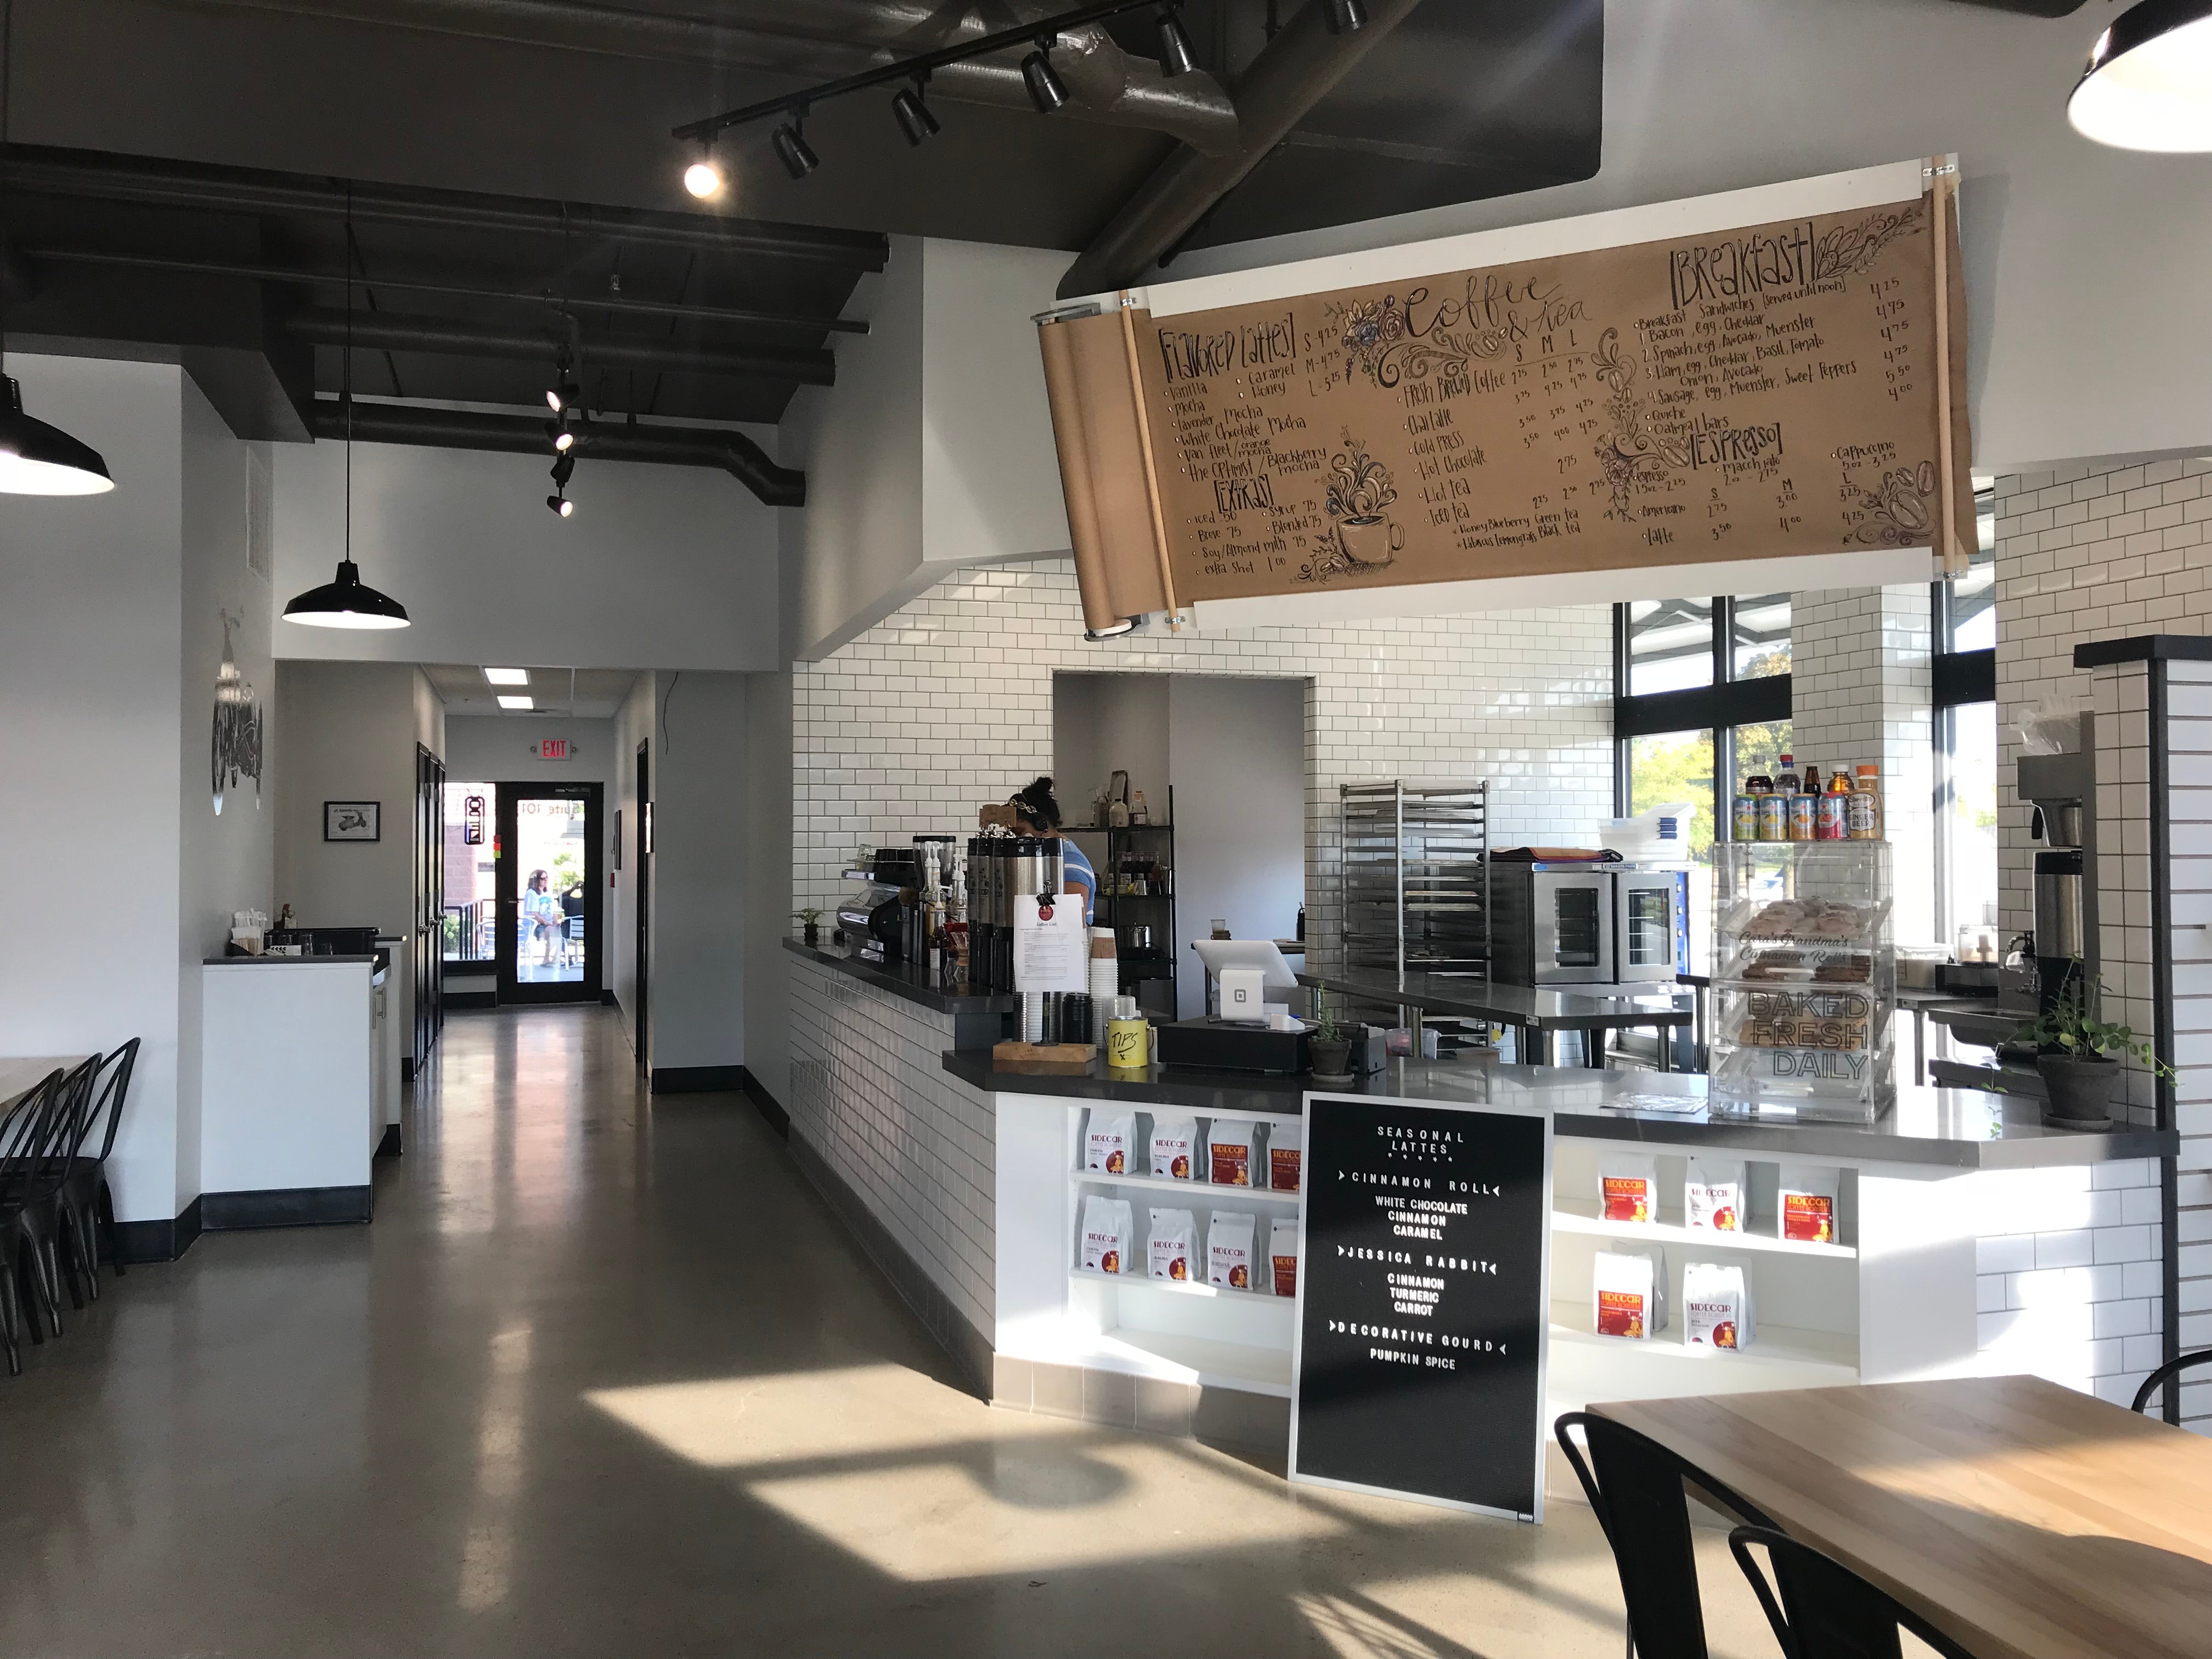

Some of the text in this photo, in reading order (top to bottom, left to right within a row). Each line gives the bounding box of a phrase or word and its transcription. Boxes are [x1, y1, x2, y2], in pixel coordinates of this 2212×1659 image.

[1402, 275, 1562, 337] Coffee
[1639, 309, 1686, 330] Breakfast
[1700, 294, 1754, 319] Sandwiches
[1507, 311, 1529, 342] &
[1724, 314, 1765, 330] Cheddar
[1765, 312, 1816, 338] Muenster
[1516, 343, 1522, 362] S
[1542, 335, 1554, 354] M
[1789, 333, 1824, 351] Tomato
[1252, 382, 1285, 398] Honey
[1474, 369, 1506, 394] Coffee
[1652, 406, 1686, 420] Quiche
[1654, 417, 1700, 435] Oatmeal
[1702, 412, 1729, 431] bars
[1180, 430, 1211, 446] White
[1215, 422, 1260, 440] Chocolate
[1241, 439, 1271, 449] orange
[1267, 448, 1327, 468] Blackberry
[1419, 445, 1487, 481] Hot Chocolate
[1424, 482, 1447, 504] Hot
[1711, 488, 1718, 498] S
[1782, 478, 1793, 491] M
[1303, 500, 1317, 511] 75
[1643, 504, 1685, 517] Americano
[1272, 515, 1322, 534] Blended 75
[1460, 507, 1578, 534] Honey Blueberry Green tea
[1538, 523, 1562, 538] Black
[1565, 521, 1581, 533] tea
[1198, 526, 1241, 541] Breve 75
[1293, 535, 1306, 548] 75
[543, 740, 566, 758] EXIT
[1781, 932, 1848, 949] Grandma's
[1740, 946, 1806, 961] Cinnamon
[1748, 990, 1869, 1019] BAKED
[1111, 1031, 1138, 1053] TIPS
[1752, 1019, 1868, 1049] FRESH
[1773, 1051, 1869, 1080] DAILY
[1377, 1126, 1464, 1143] SEASONAL
[1392, 1141, 1447, 1154] LATTES
[1352, 1172, 1489, 1195] CINNAMON ROLL
[1375, 1195, 1468, 1215] WHITE CHOCOLATE
[1388, 1210, 1446, 1227] CINNAMON
[1393, 1224, 1443, 1241] CARAMEL
[1275, 1257, 1297, 1265] SIDEC
[1347, 1246, 1488, 1273] JESSICA RABBIT
[1387, 1273, 1444, 1290] CINNAMON
[1390, 1287, 1439, 1304] TURMERIC
[1393, 1301, 1433, 1317] CARROT
[1338, 1321, 1492, 1352] DECORATIVE GOURD
[1370, 1347, 1455, 1370] PUMPKIN SPICE
